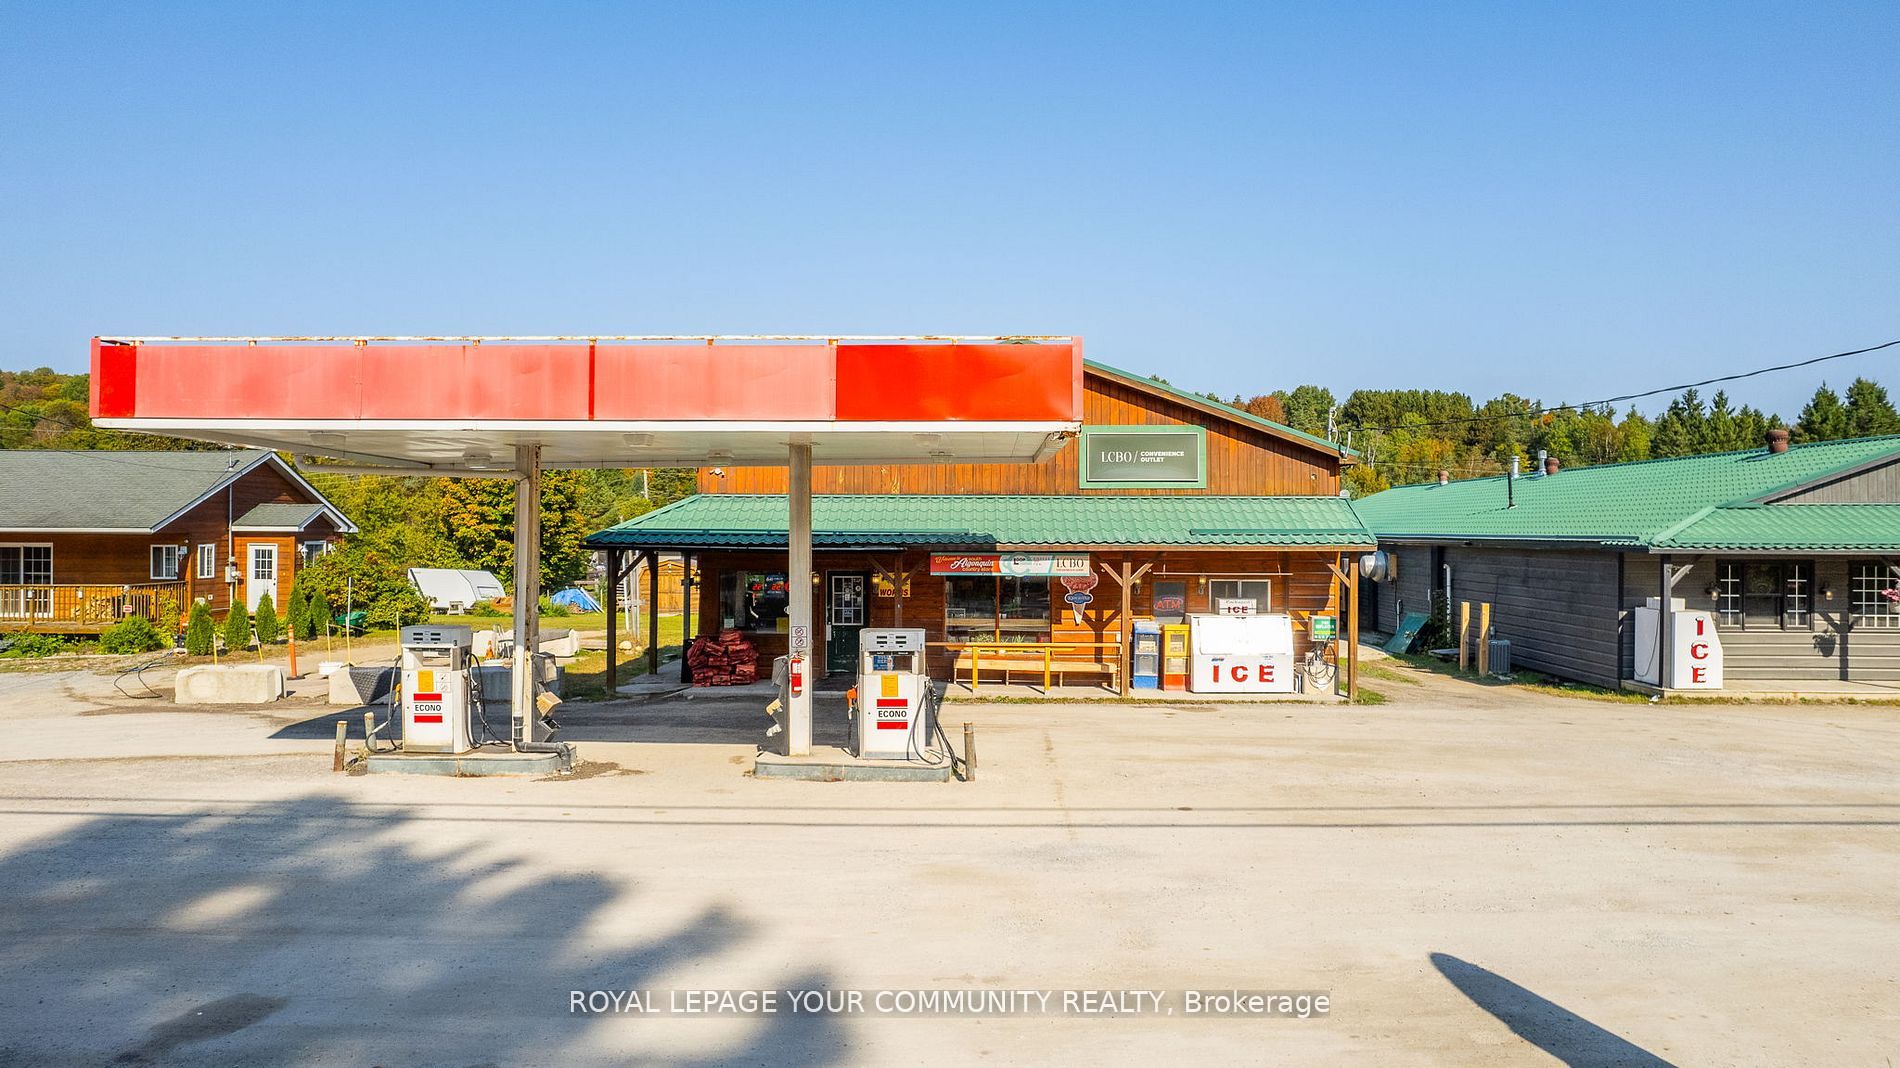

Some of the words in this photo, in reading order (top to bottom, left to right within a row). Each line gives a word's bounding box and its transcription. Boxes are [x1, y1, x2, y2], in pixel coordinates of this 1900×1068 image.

[1101, 451, 1132, 463] LCBO
[1056, 558, 1084, 568] LCBO
[1157, 599, 1180, 609] ATM
[1228, 606, 1248, 614] ICE
[1690, 619, 1709, 684] ICE
[1213, 664, 1275, 683] ICE
[414, 704, 442, 712] ECONO
[878, 710, 907, 718] ECONO
